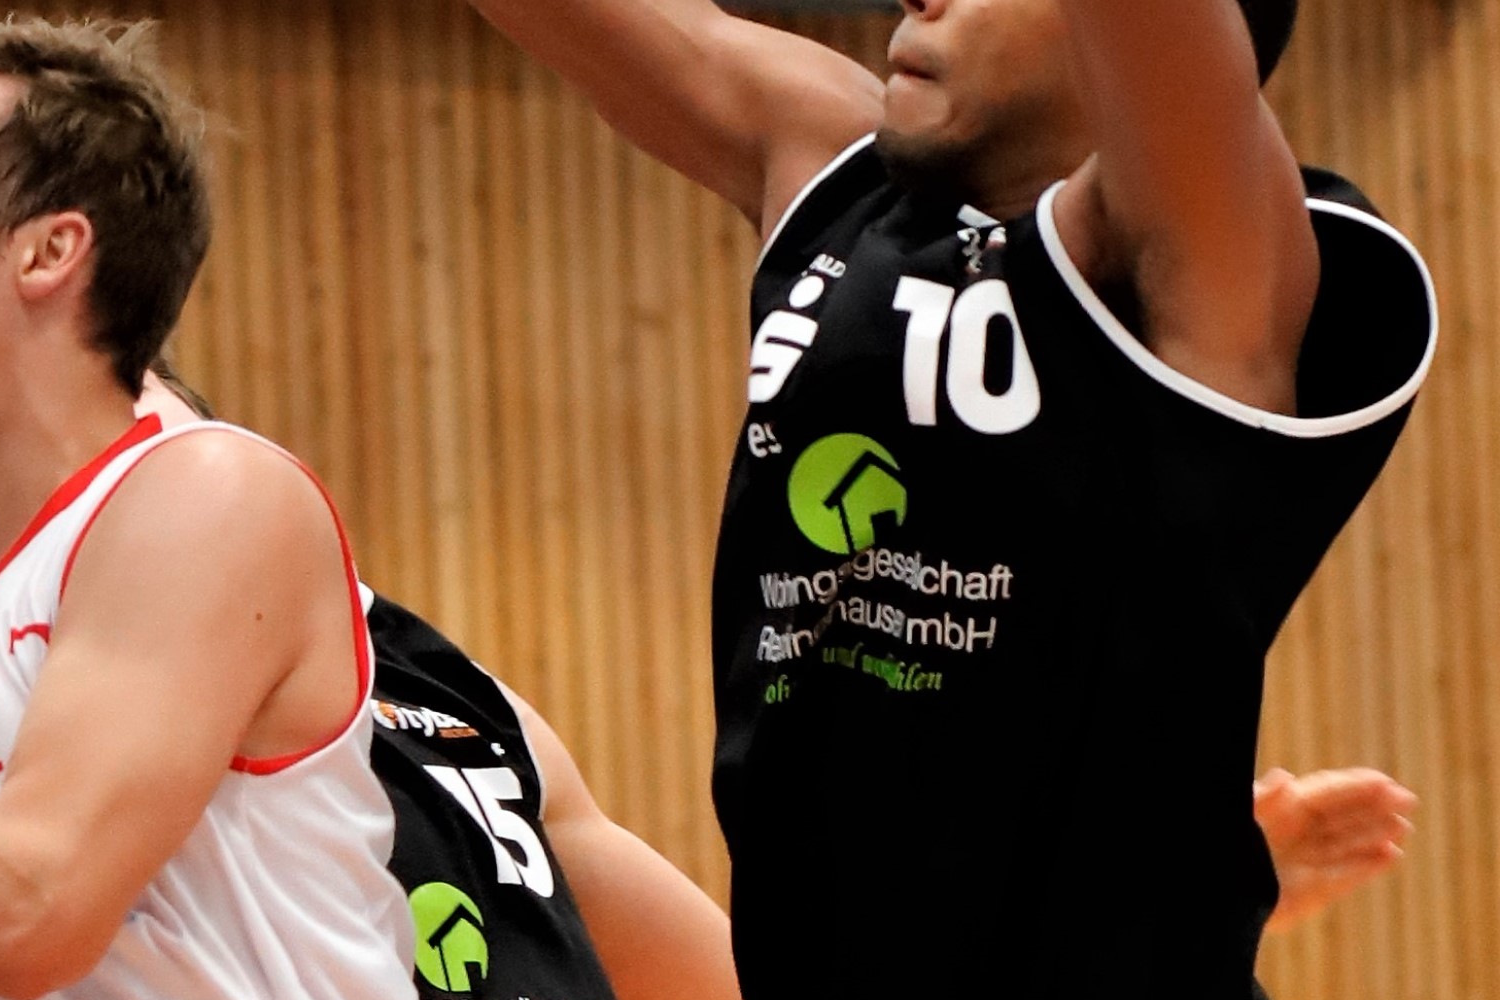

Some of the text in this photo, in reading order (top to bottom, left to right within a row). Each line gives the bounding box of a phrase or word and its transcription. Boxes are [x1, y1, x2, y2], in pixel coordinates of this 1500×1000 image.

[893, 275, 1041, 434] 10
[906, 612, 998, 653] mbH
[423, 764, 554, 898] 15
